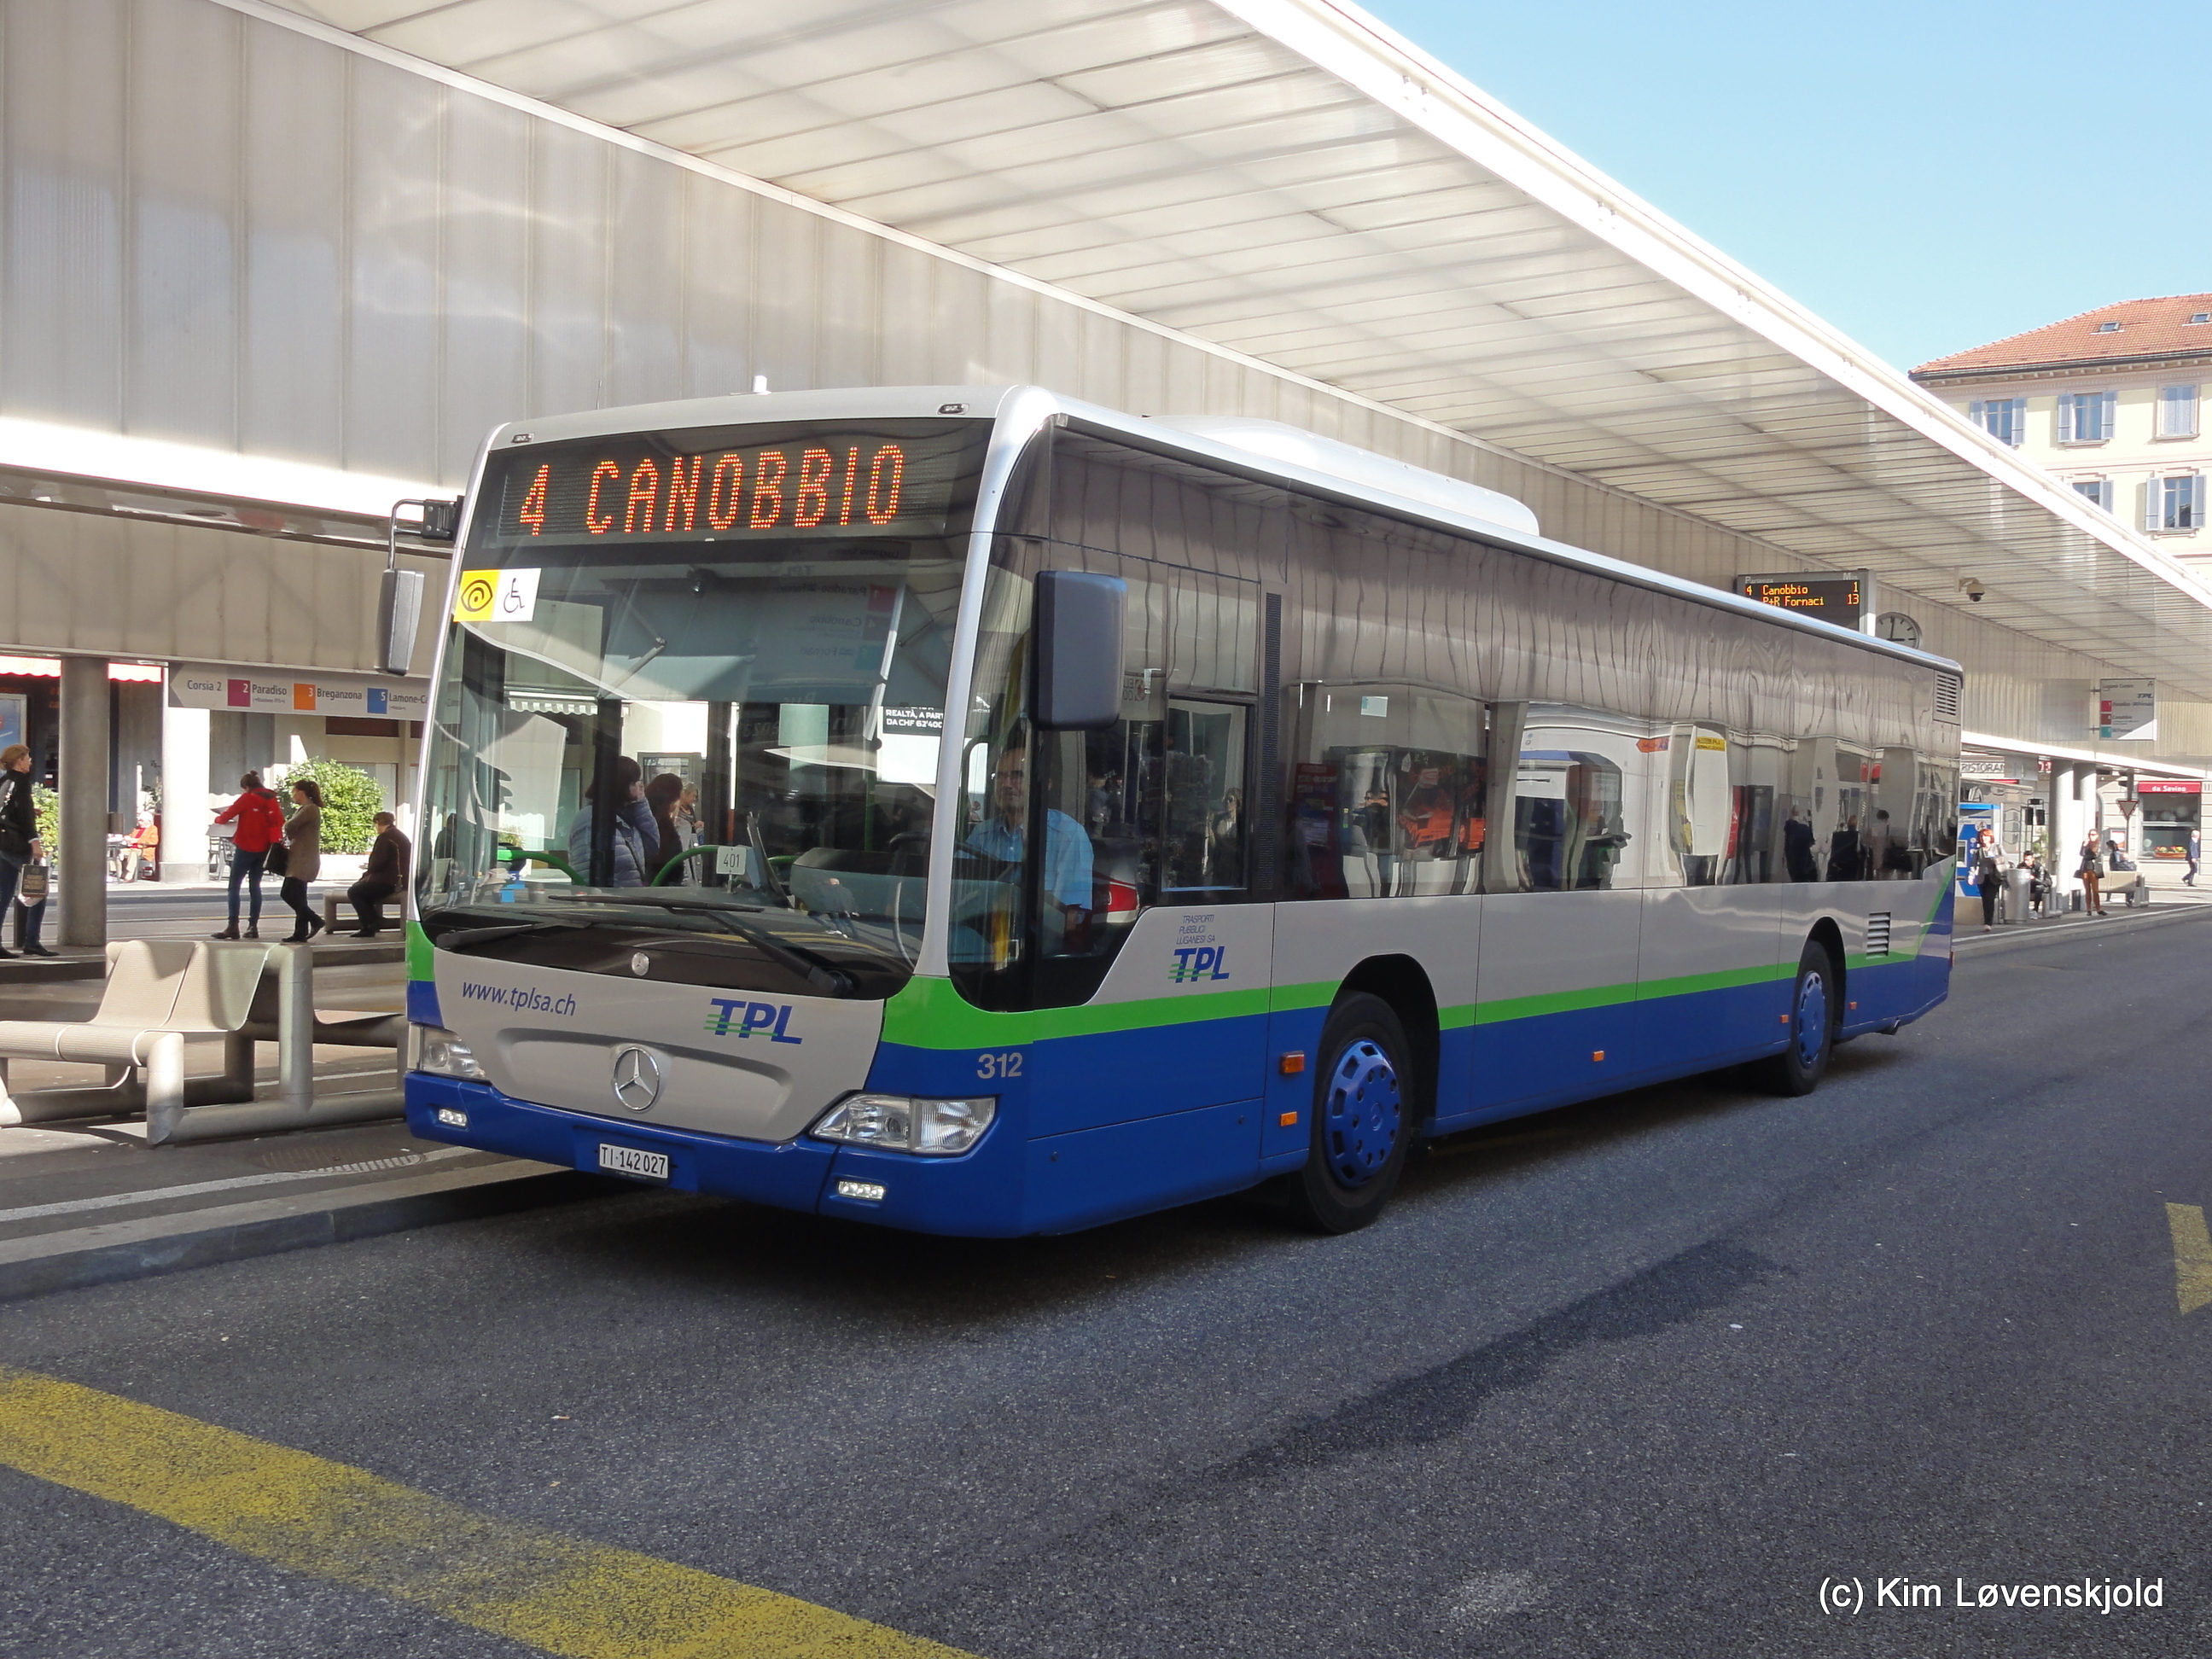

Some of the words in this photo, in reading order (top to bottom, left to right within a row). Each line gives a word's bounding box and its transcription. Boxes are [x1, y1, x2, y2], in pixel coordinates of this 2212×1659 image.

[520, 463, 550, 536] 4
[585, 443, 904, 535] CANOBBIO
[1746, 585, 1753, 596] 4
[1762, 584, 1808, 596] Canobbio
[1854, 581, 1859, 592] 1
[1784, 596, 1825, 607] Fornaci
[1847, 593, 1860, 605] 13
[187, 679, 214, 691] Corsia
[216, 681, 222, 691] 2
[242, 683, 249, 693] 2
[252, 684, 288, 696] Paradiso
[308, 686, 314, 697] 3
[317, 688, 363, 700] Breganzona
[381, 691, 386, 701] 5
[886, 708, 918, 719] REALTÀ,
[899, 719, 915, 727] CHF
[723, 853, 740, 868] 401
[1182, 914, 1215, 923] TRASPORTI
[1176, 935, 1206, 945] LUGANESI
[1207, 934, 1216, 943] SA
[1173, 946, 1231, 983] TPL
[462, 981, 577, 1016] www.tplsa.ch
[708, 998, 803, 1045] TPL
[977, 1052, 1023, 1080] 312
